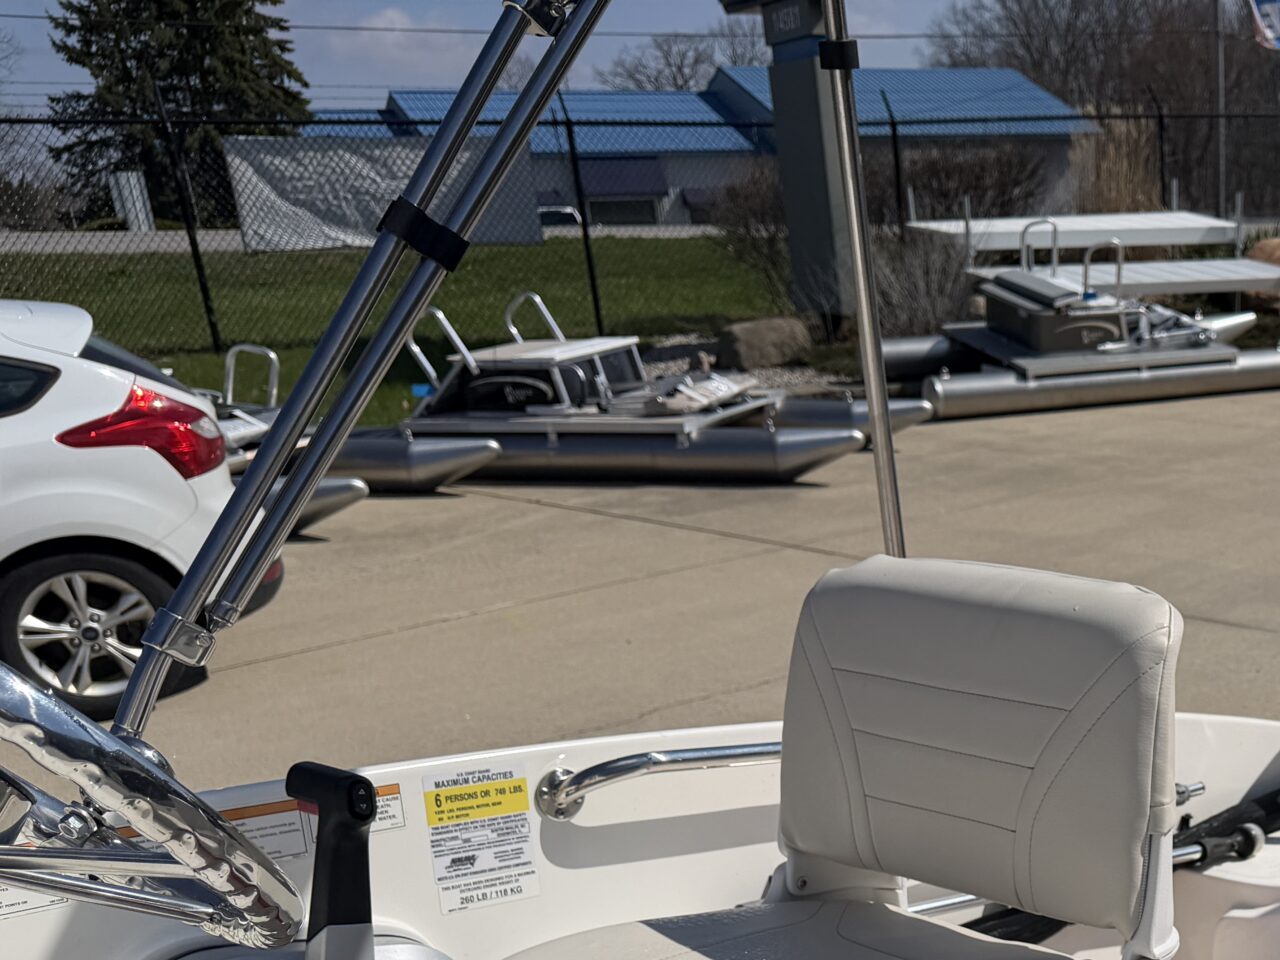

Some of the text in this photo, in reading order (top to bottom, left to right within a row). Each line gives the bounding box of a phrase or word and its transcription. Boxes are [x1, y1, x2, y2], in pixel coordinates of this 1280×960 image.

[434, 771, 514, 789] MAXIMUM CAPACITIES
[434, 793, 442, 808] 6
[445, 792, 479, 804] PERSONS
[480, 789, 491, 798] OR
[459, 895, 475, 905] 260
[476, 892, 488, 902] LB
[495, 888, 508, 898] 118
[510, 885, 523, 895] KG
